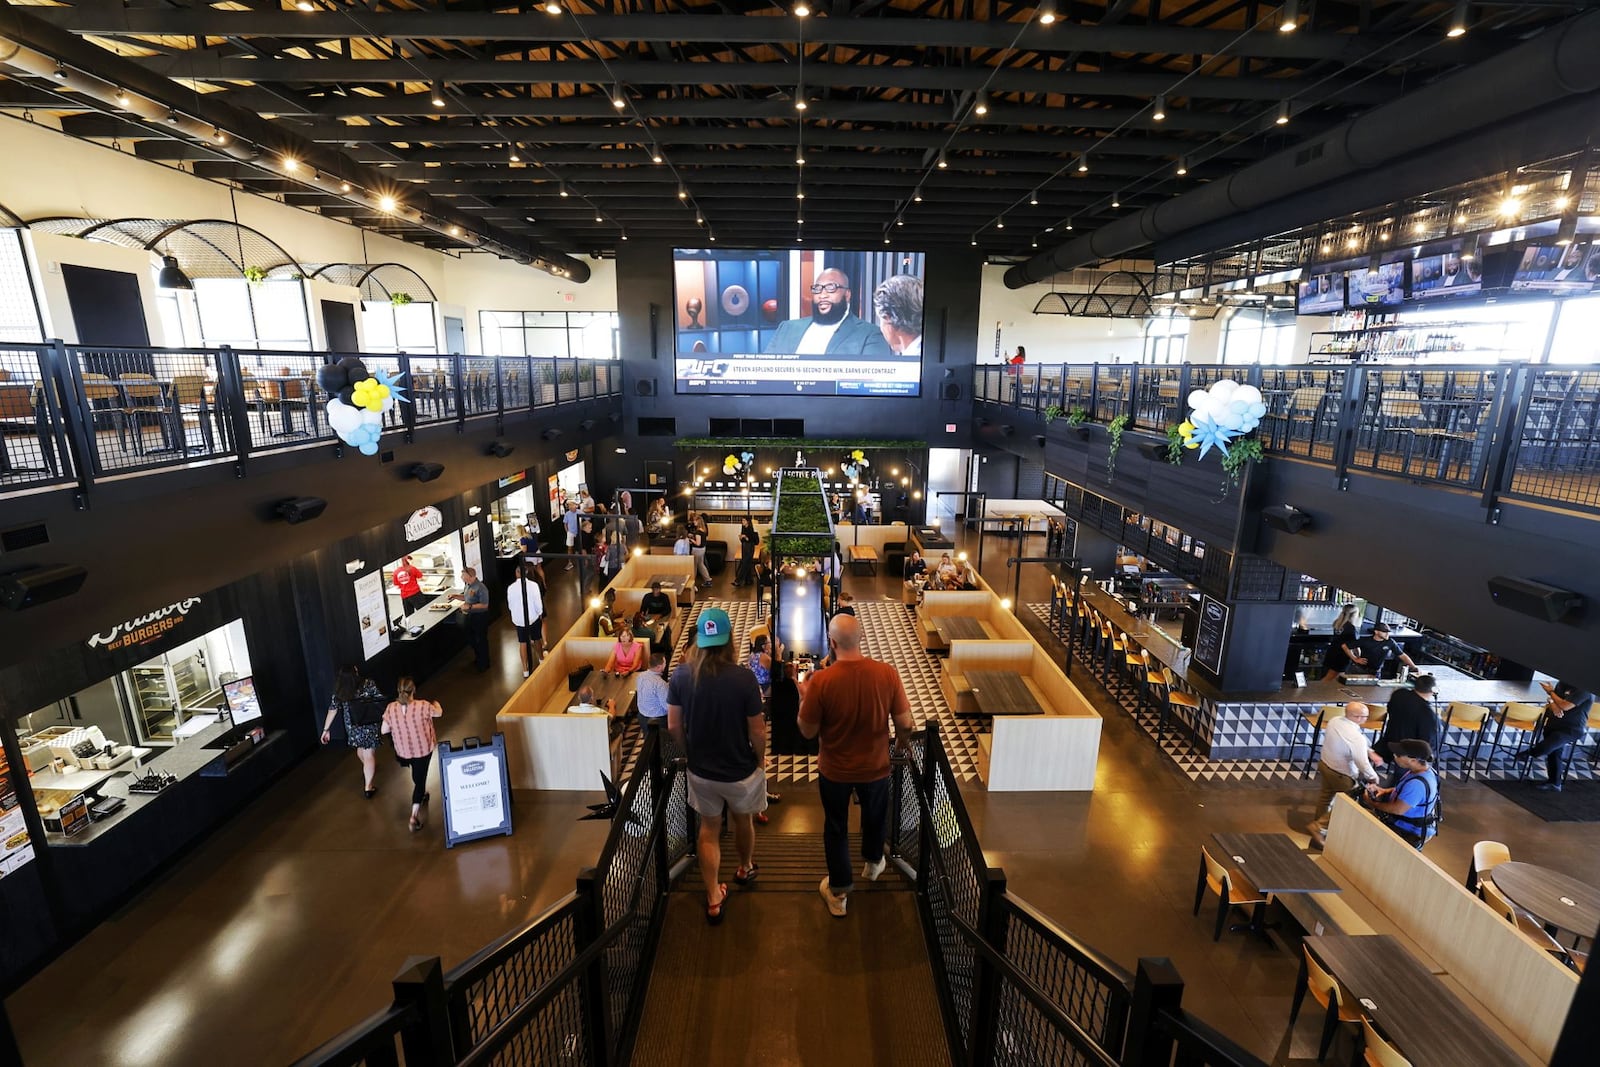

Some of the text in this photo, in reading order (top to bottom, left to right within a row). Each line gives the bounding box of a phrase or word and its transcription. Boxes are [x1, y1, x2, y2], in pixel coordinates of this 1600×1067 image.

[692, 360, 728, 377] UFC
[772, 470, 829, 479] COLECTIVE PUR
[123, 617, 174, 647] BURGERS
